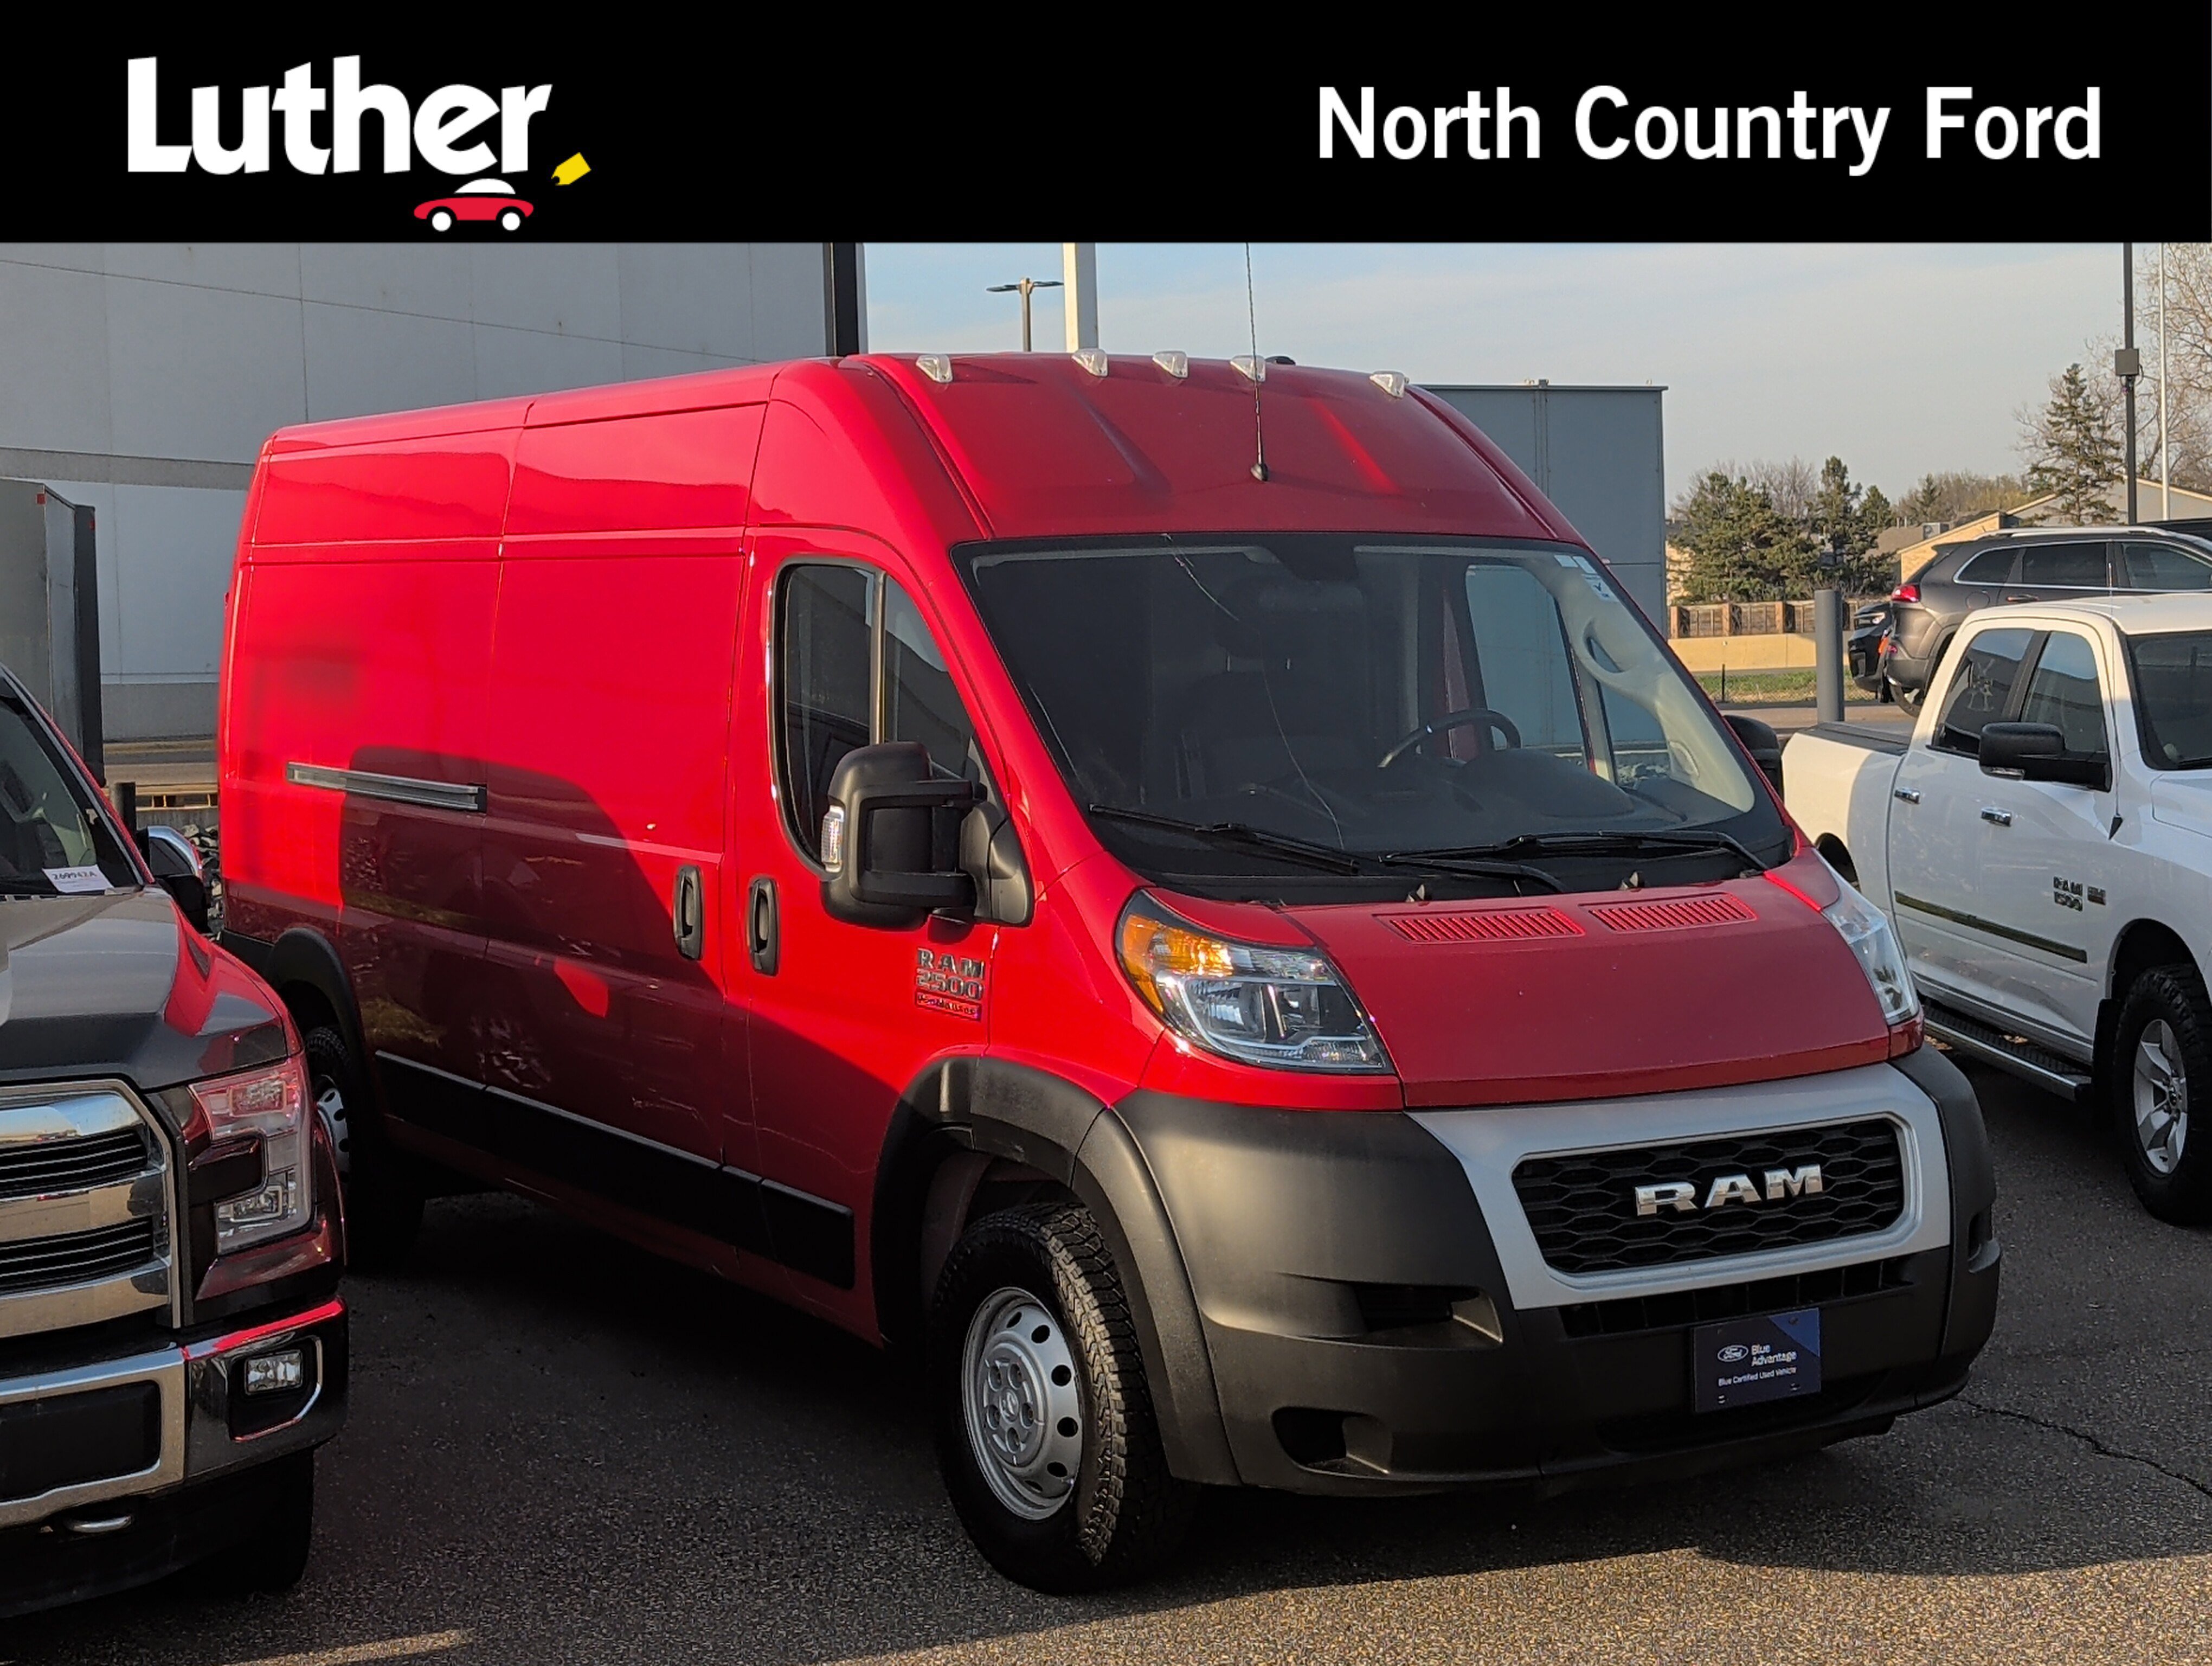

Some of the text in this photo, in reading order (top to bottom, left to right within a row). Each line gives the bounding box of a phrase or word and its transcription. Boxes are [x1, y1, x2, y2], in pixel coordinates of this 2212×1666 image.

[917, 947, 985, 979] RAM
[916, 968, 985, 1000] 2500
[1635, 1164, 1823, 1216] RAM
[1721, 1346, 1744, 1360] Ford
[1751, 1344, 1771, 1355] Blue
[1751, 1351, 1797, 1367] Advantage
[1718, 1367, 1797, 1387] Blue Certified Used Vehicle
